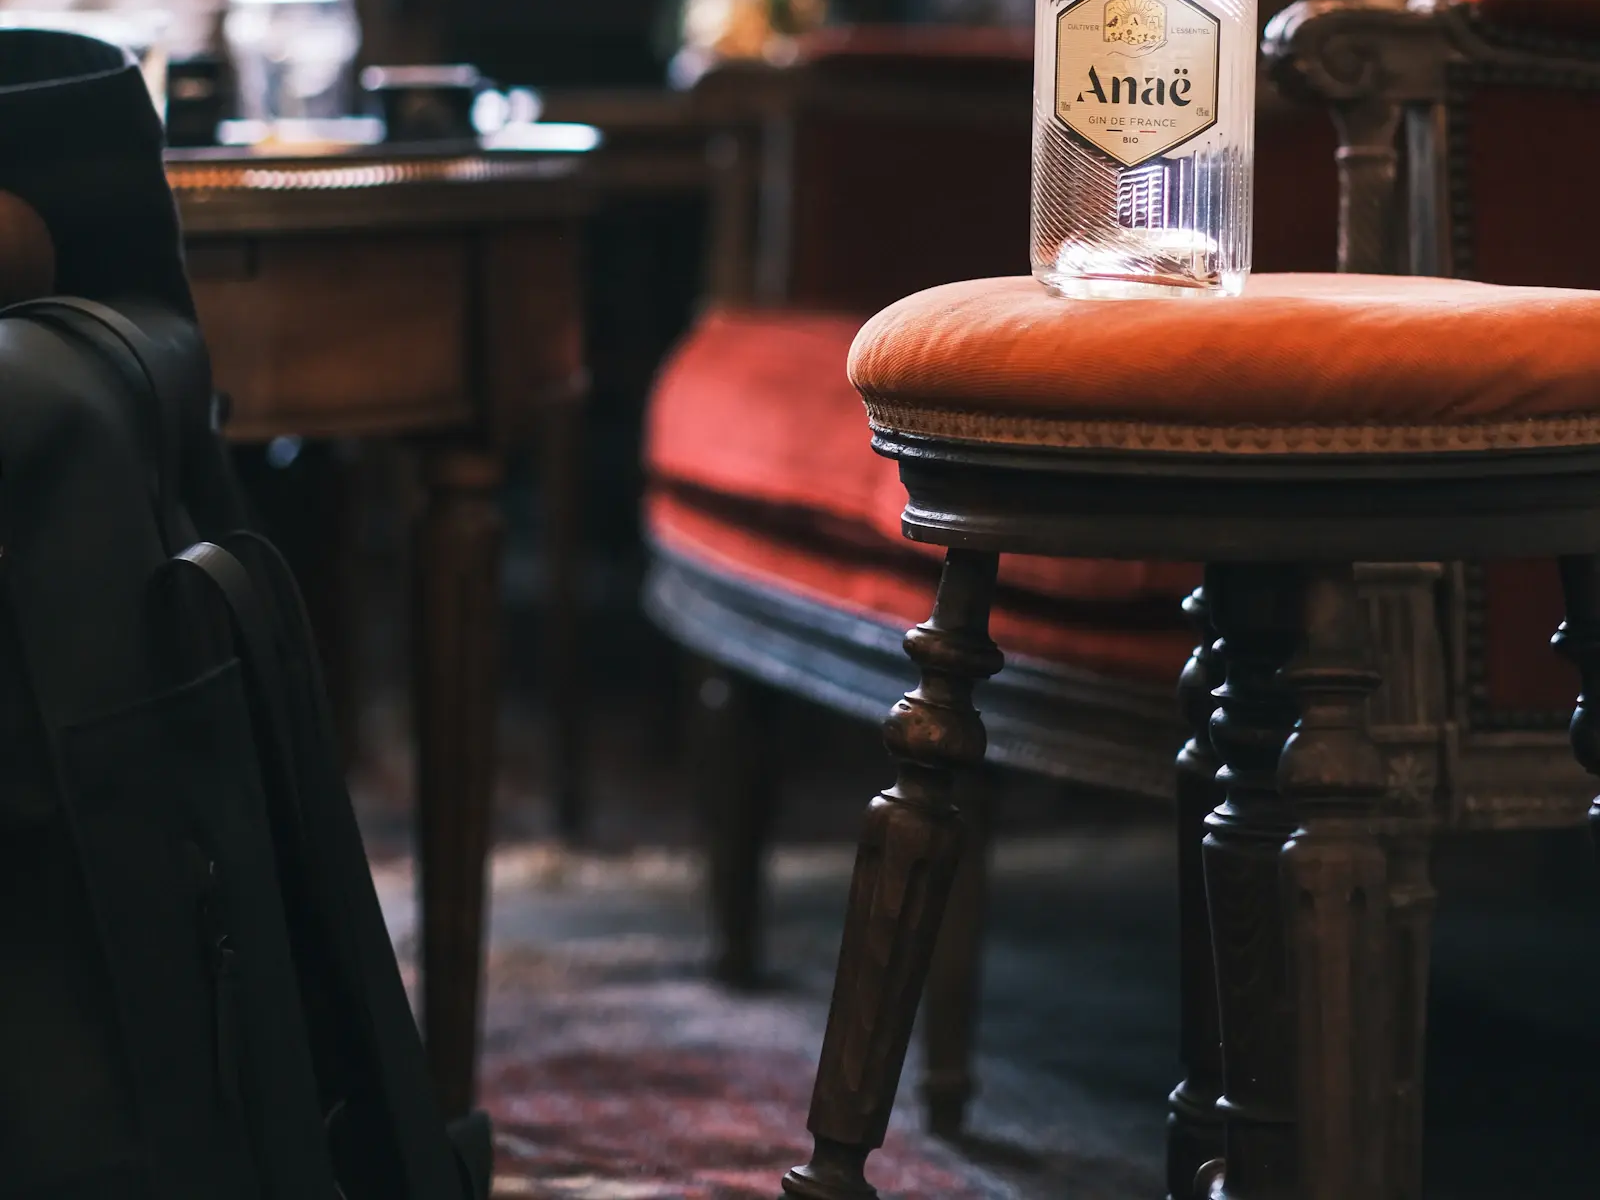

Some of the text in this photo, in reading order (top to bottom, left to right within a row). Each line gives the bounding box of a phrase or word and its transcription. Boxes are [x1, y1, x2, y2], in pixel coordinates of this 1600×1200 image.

[1067, 23, 1100, 31] CULTIVER
[1076, 65, 1192, 107] Anaë
[1088, 115, 1177, 128] GIN DE FRANCE
[1122, 136, 1139, 144] BIO
